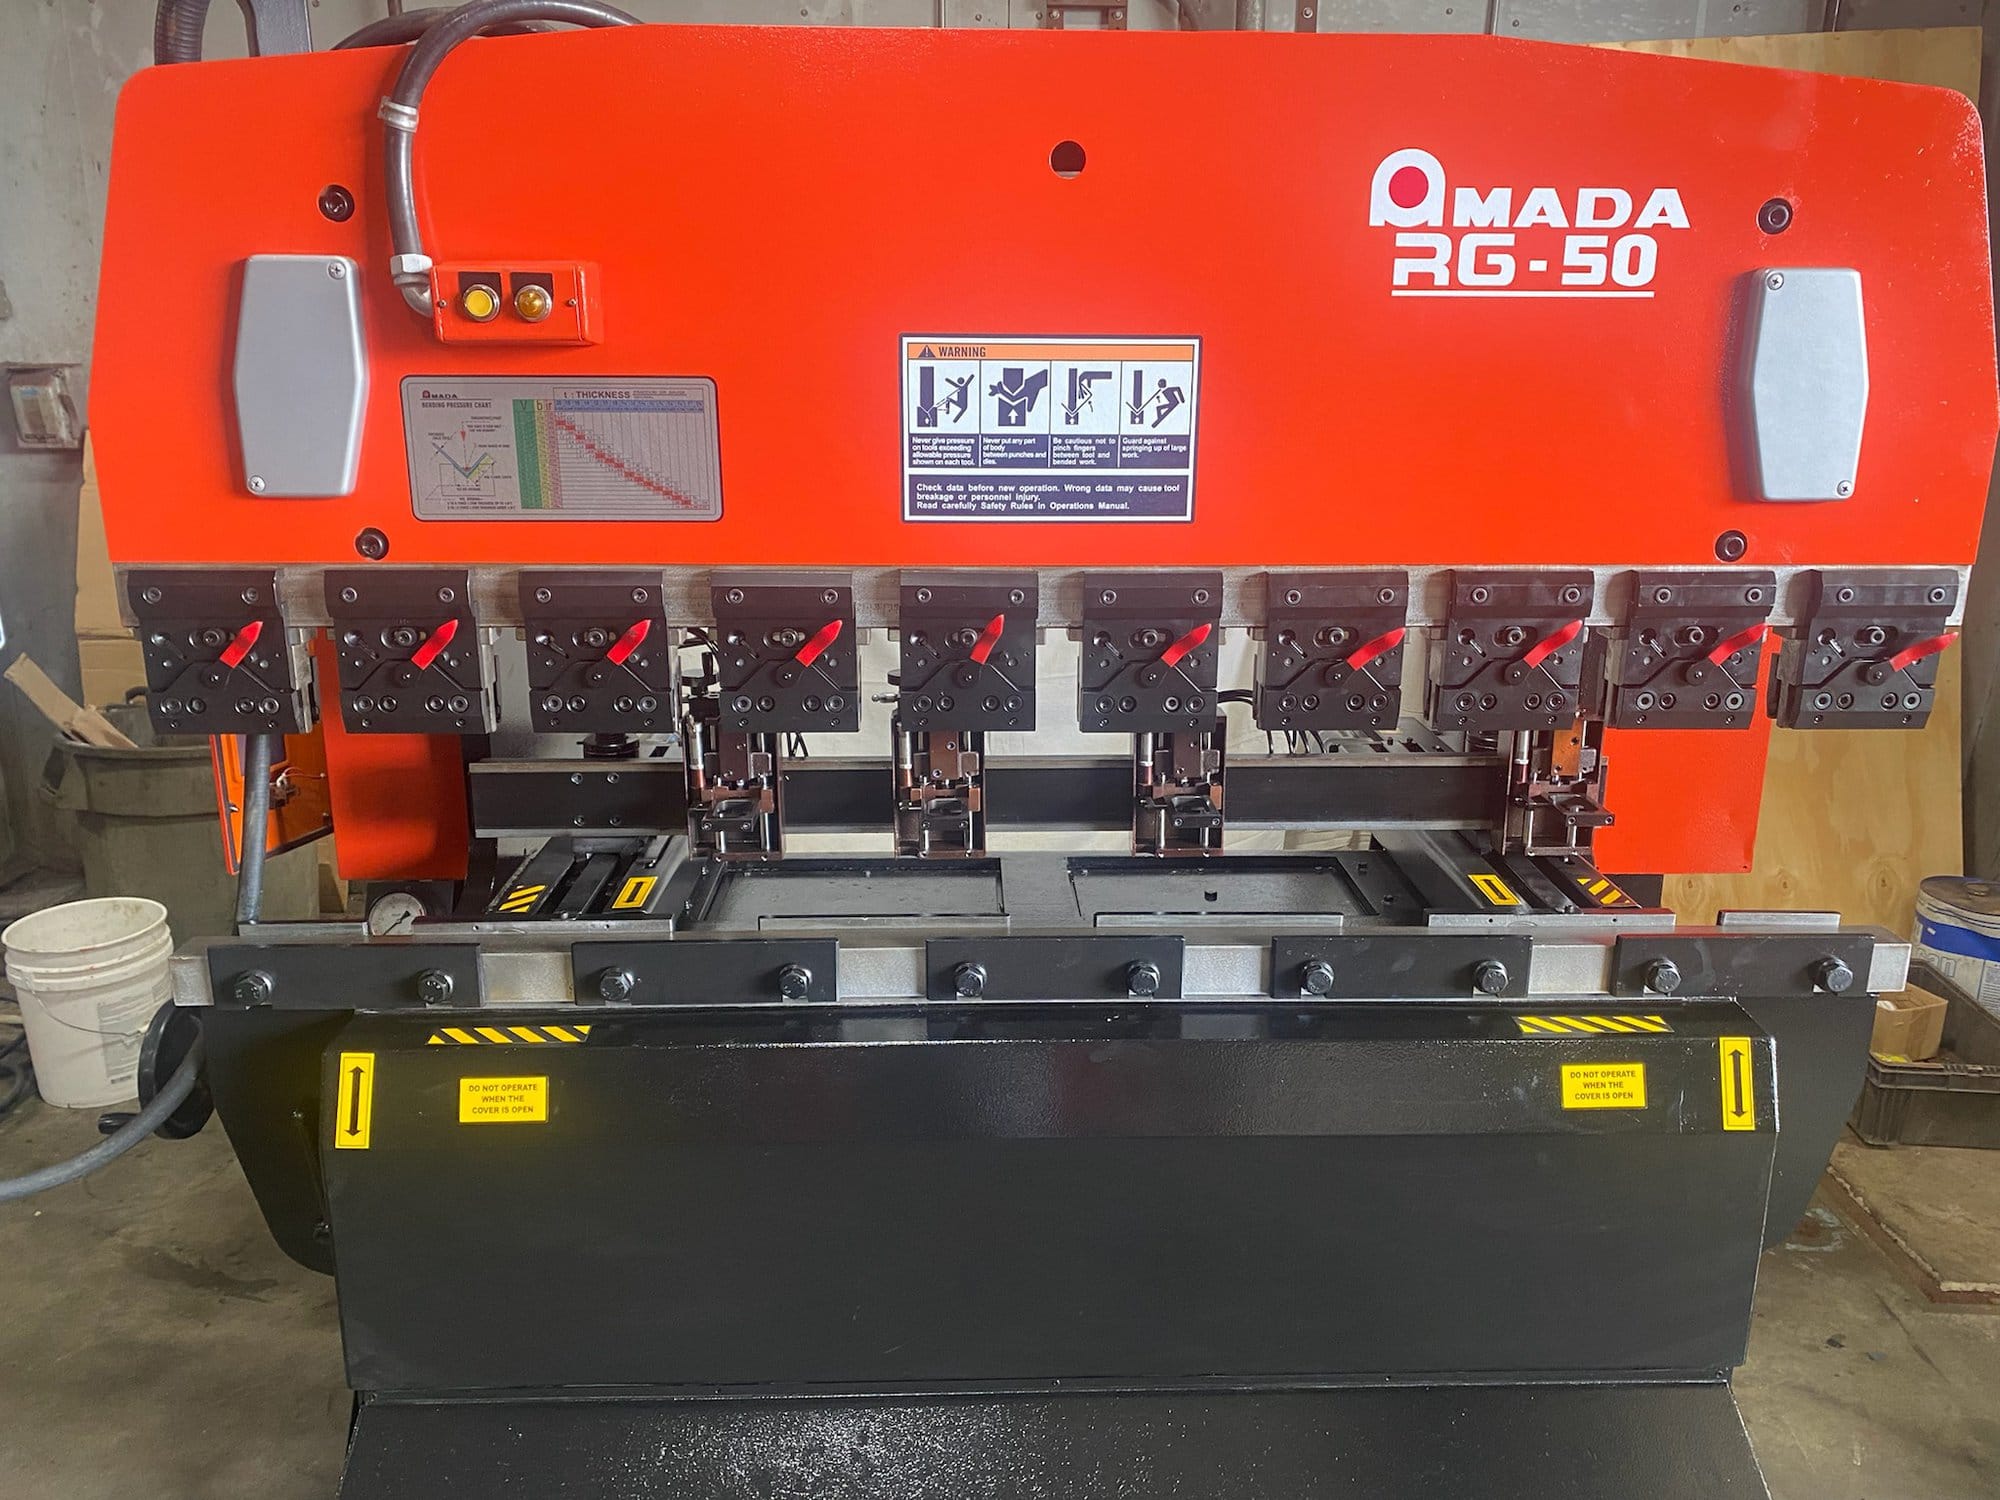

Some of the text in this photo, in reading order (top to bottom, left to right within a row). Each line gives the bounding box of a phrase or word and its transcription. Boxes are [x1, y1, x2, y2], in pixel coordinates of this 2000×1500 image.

[1369, 148, 1691, 228] AMADA
[938, 346, 986, 357] WARNING
[422, 390, 457, 398] AMADA
[577, 390, 630, 399] THICKNESS
[520, 400, 527, 410] V
[537, 400, 542, 410] b
[932, 437, 945, 446] give
[1019, 485, 1059, 493] operation.
[1064, 484, 1091, 493] Wrong
[916, 493, 953, 502] breakage
[971, 494, 1011, 502] personnel
[1016, 494, 1040, 502] injury.
[942, 502, 976, 511] carefully
[981, 502, 1006, 511] Safety
[1050, 502, 1094, 510] Operations
